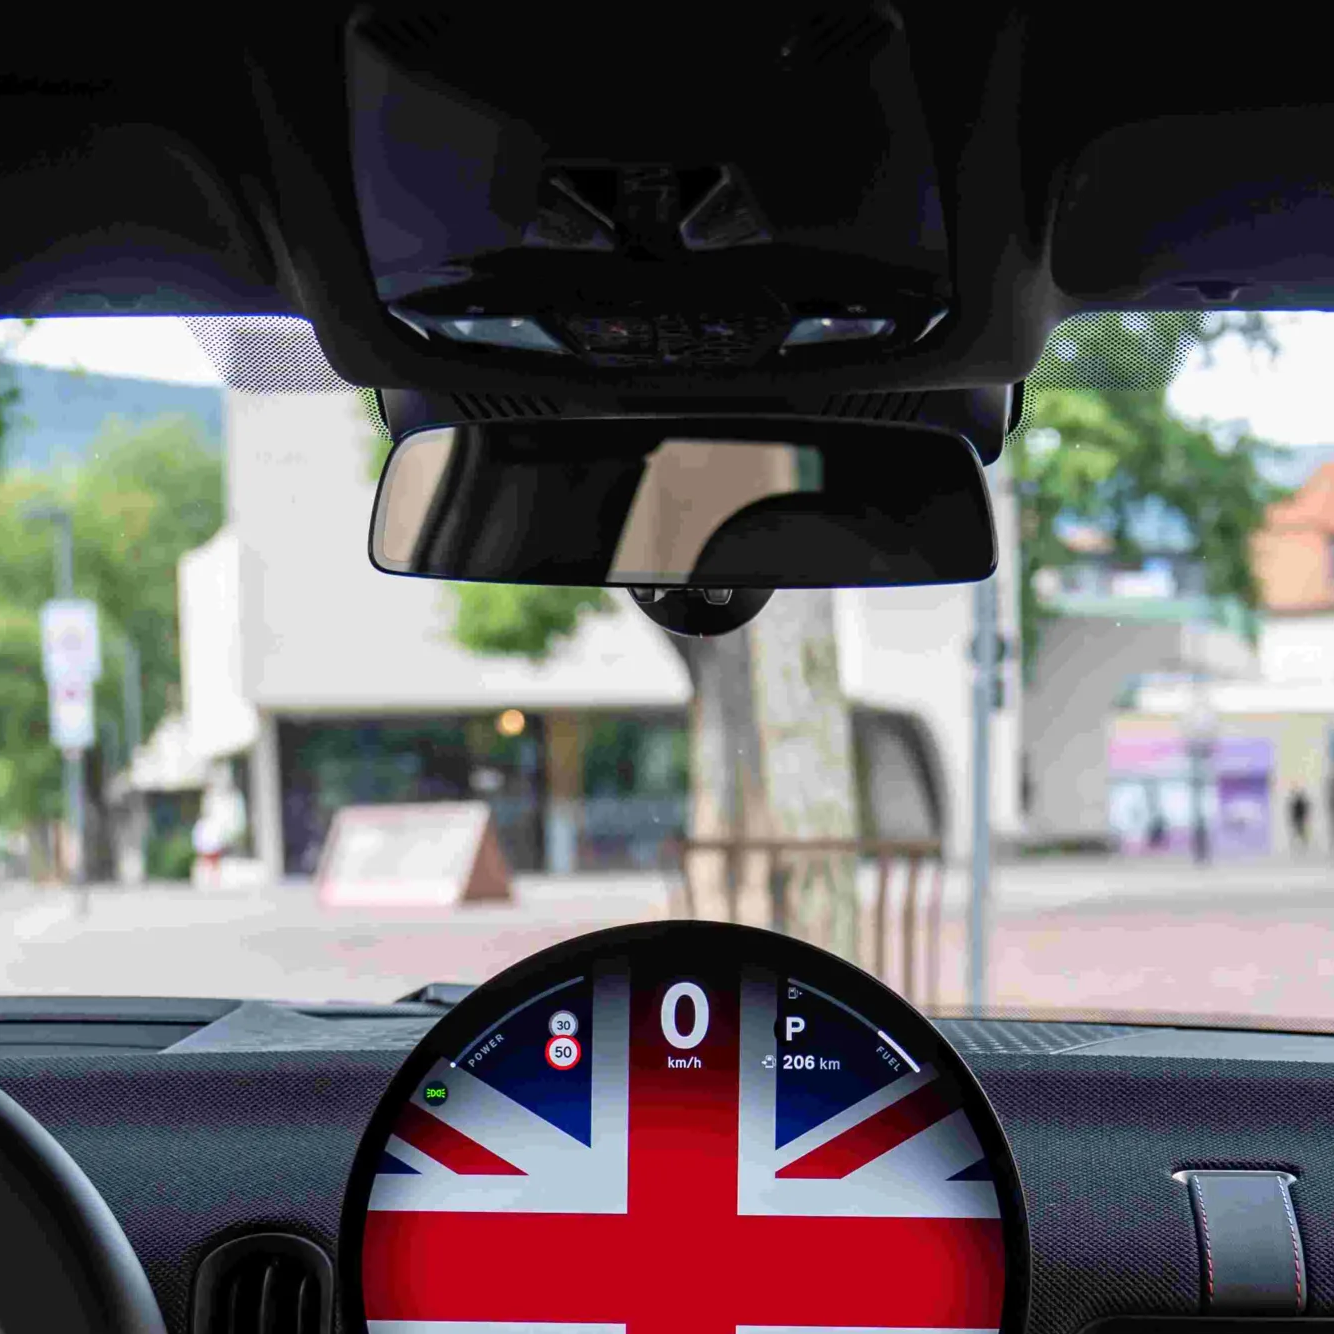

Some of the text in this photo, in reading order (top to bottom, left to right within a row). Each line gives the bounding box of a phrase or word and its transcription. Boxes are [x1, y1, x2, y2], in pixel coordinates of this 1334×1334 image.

[556, 1020, 571, 1031] 30
[660, 982, 709, 1049] 0
[786, 1016, 805, 1041] P
[468, 1033, 505, 1067] POWER
[554, 1046, 572, 1059] 50
[875, 1045, 900, 1072] FUEL
[667, 1056, 702, 1069] km/h
[783, 1055, 841, 1070] 206 km
